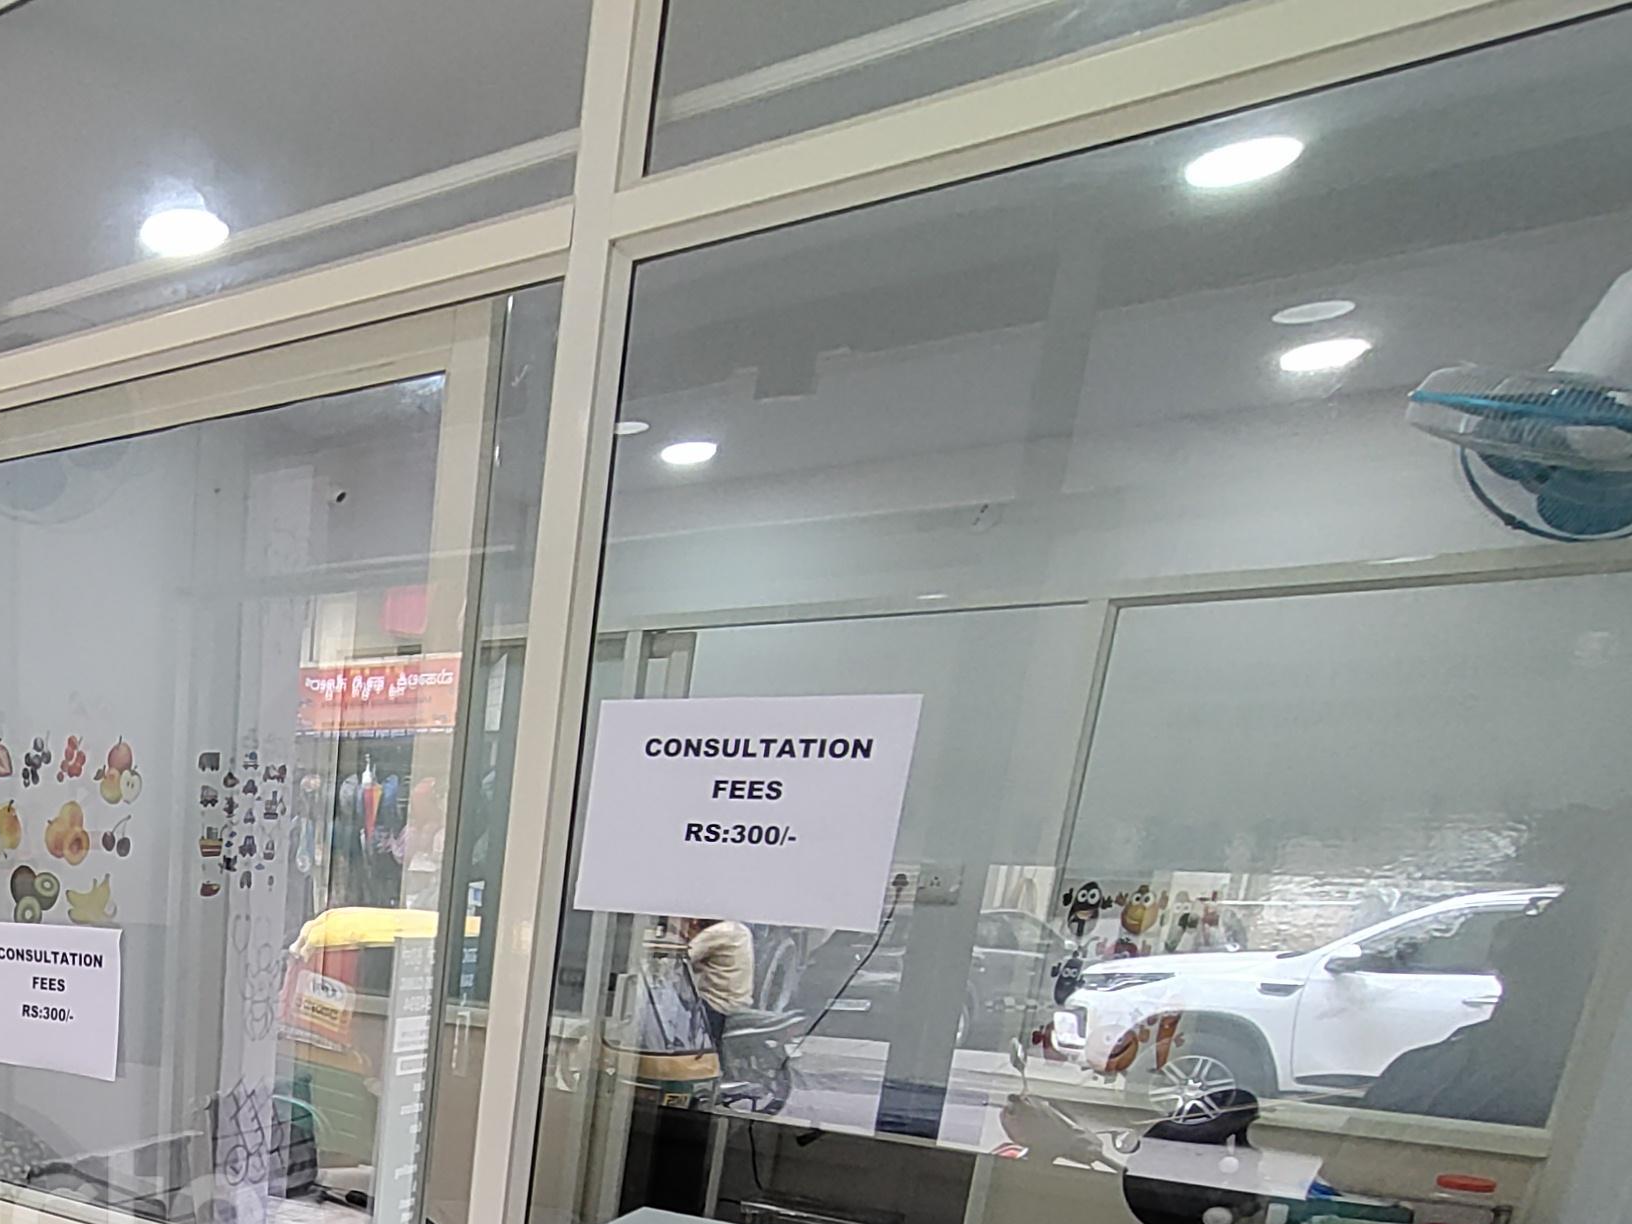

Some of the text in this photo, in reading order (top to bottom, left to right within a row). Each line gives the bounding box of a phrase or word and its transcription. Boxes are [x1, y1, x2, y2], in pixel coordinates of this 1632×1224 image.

[644, 737, 874, 760] CONSULTATION
[712, 780, 784, 801] FEES
[684, 823, 798, 847] RS:300/-
[32, 976, 66, 992] FEES
[21, 1004, 74, 1023] RS:300/-
